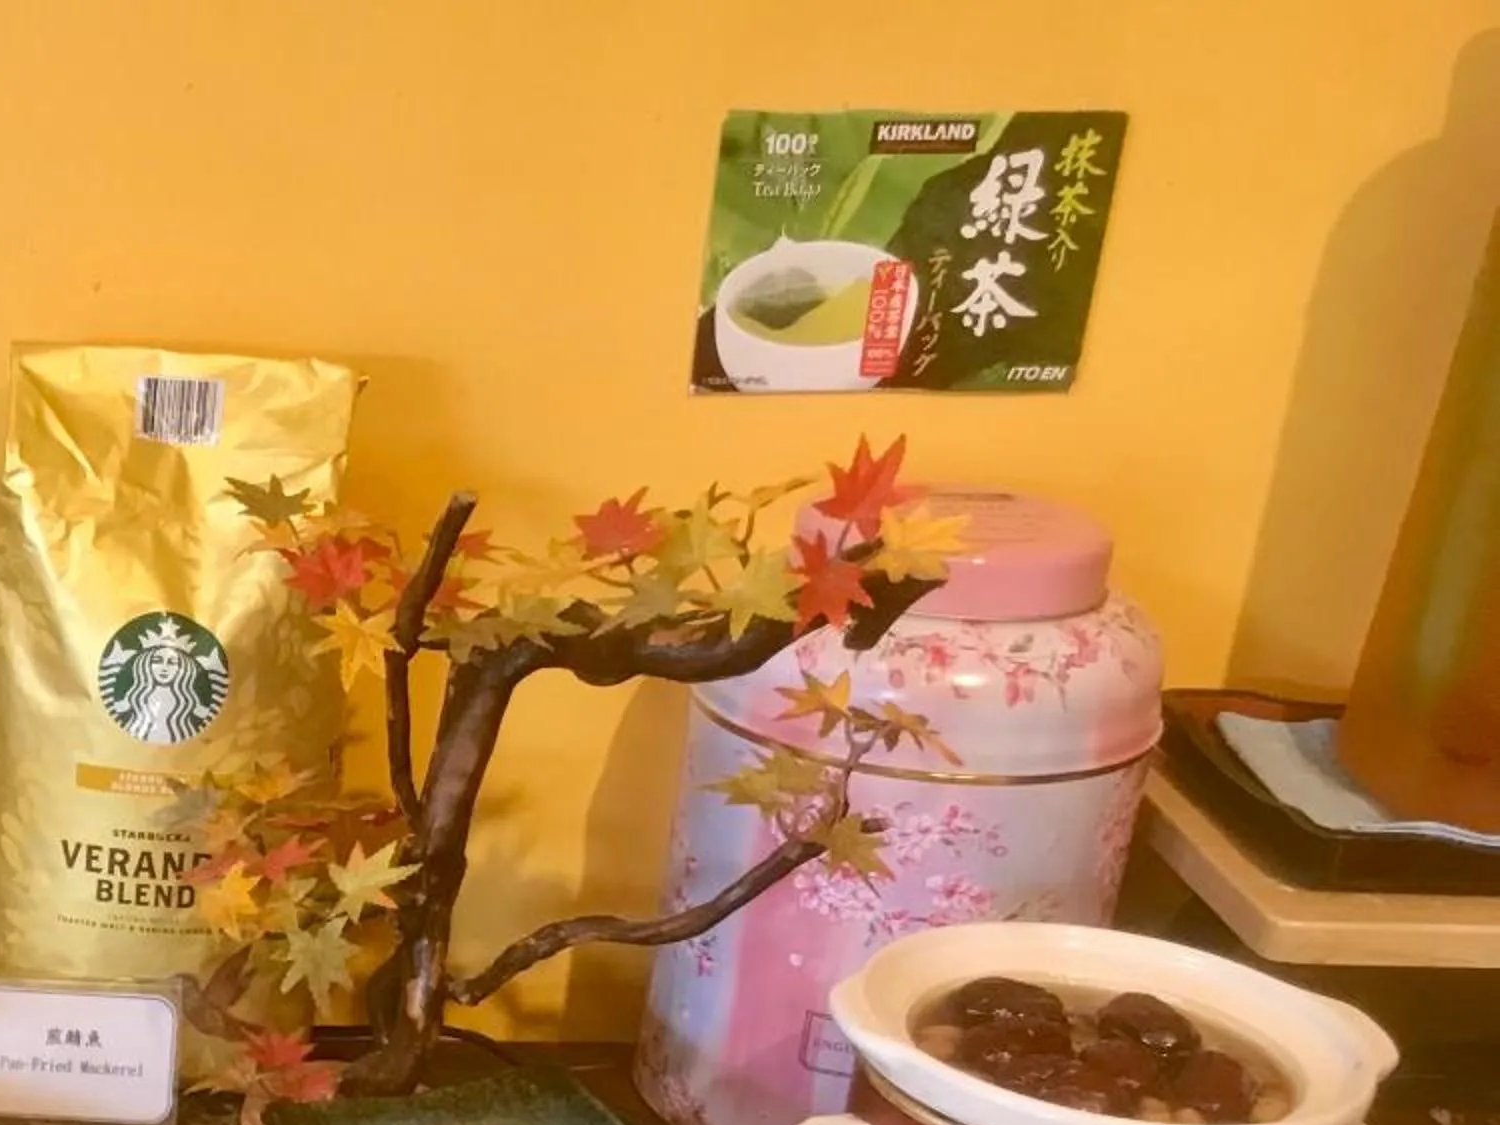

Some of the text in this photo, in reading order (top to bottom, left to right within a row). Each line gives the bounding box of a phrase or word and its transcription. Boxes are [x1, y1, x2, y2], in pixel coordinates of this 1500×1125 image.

[877, 123, 976, 141] KIRKLAND
[950, 147, 1049, 338] 緑茶
[96, 879, 196, 909] BLEND
[0, 1055, 144, 1078] Pan-Fried Mackerel
